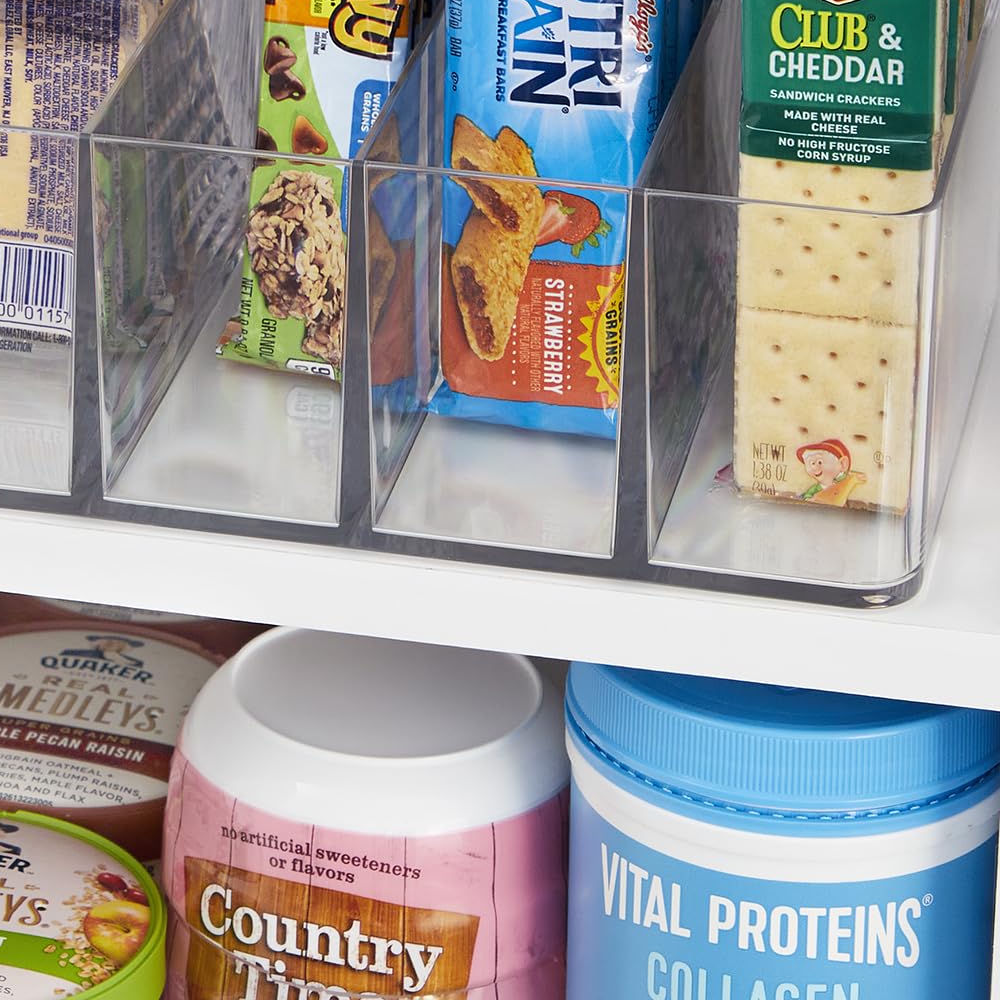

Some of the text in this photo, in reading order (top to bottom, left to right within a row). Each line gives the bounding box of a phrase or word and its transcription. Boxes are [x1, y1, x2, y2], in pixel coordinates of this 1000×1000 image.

[770, 3, 902, 51] CLUB &
[769, 51, 904, 85] CHEDDAR
[495, 68, 506, 102] BARS
[770, 89, 901, 107] SANDWICH CRACKERS
[784, 110, 886, 125] MADE WITH REAL
[811, 122, 858, 135] CHEESE
[778, 137, 890, 154] NO HIGH FRUCTOSE
[797, 148, 872, 164] CORN SYRUP
[543, 278, 565, 395] STRAWBERRY
[605, 310, 618, 366] GRAINS
[39, 655, 154, 684] QUAKER
[25, 732, 82, 752] PECAN
[86, 742, 146, 764] RAISIN
[221, 825, 422, 880] no artificial sweeteners
[269, 856, 355, 884] or flavors
[601, 842, 692, 939] VITAL
[200, 883, 443, 992] Country
